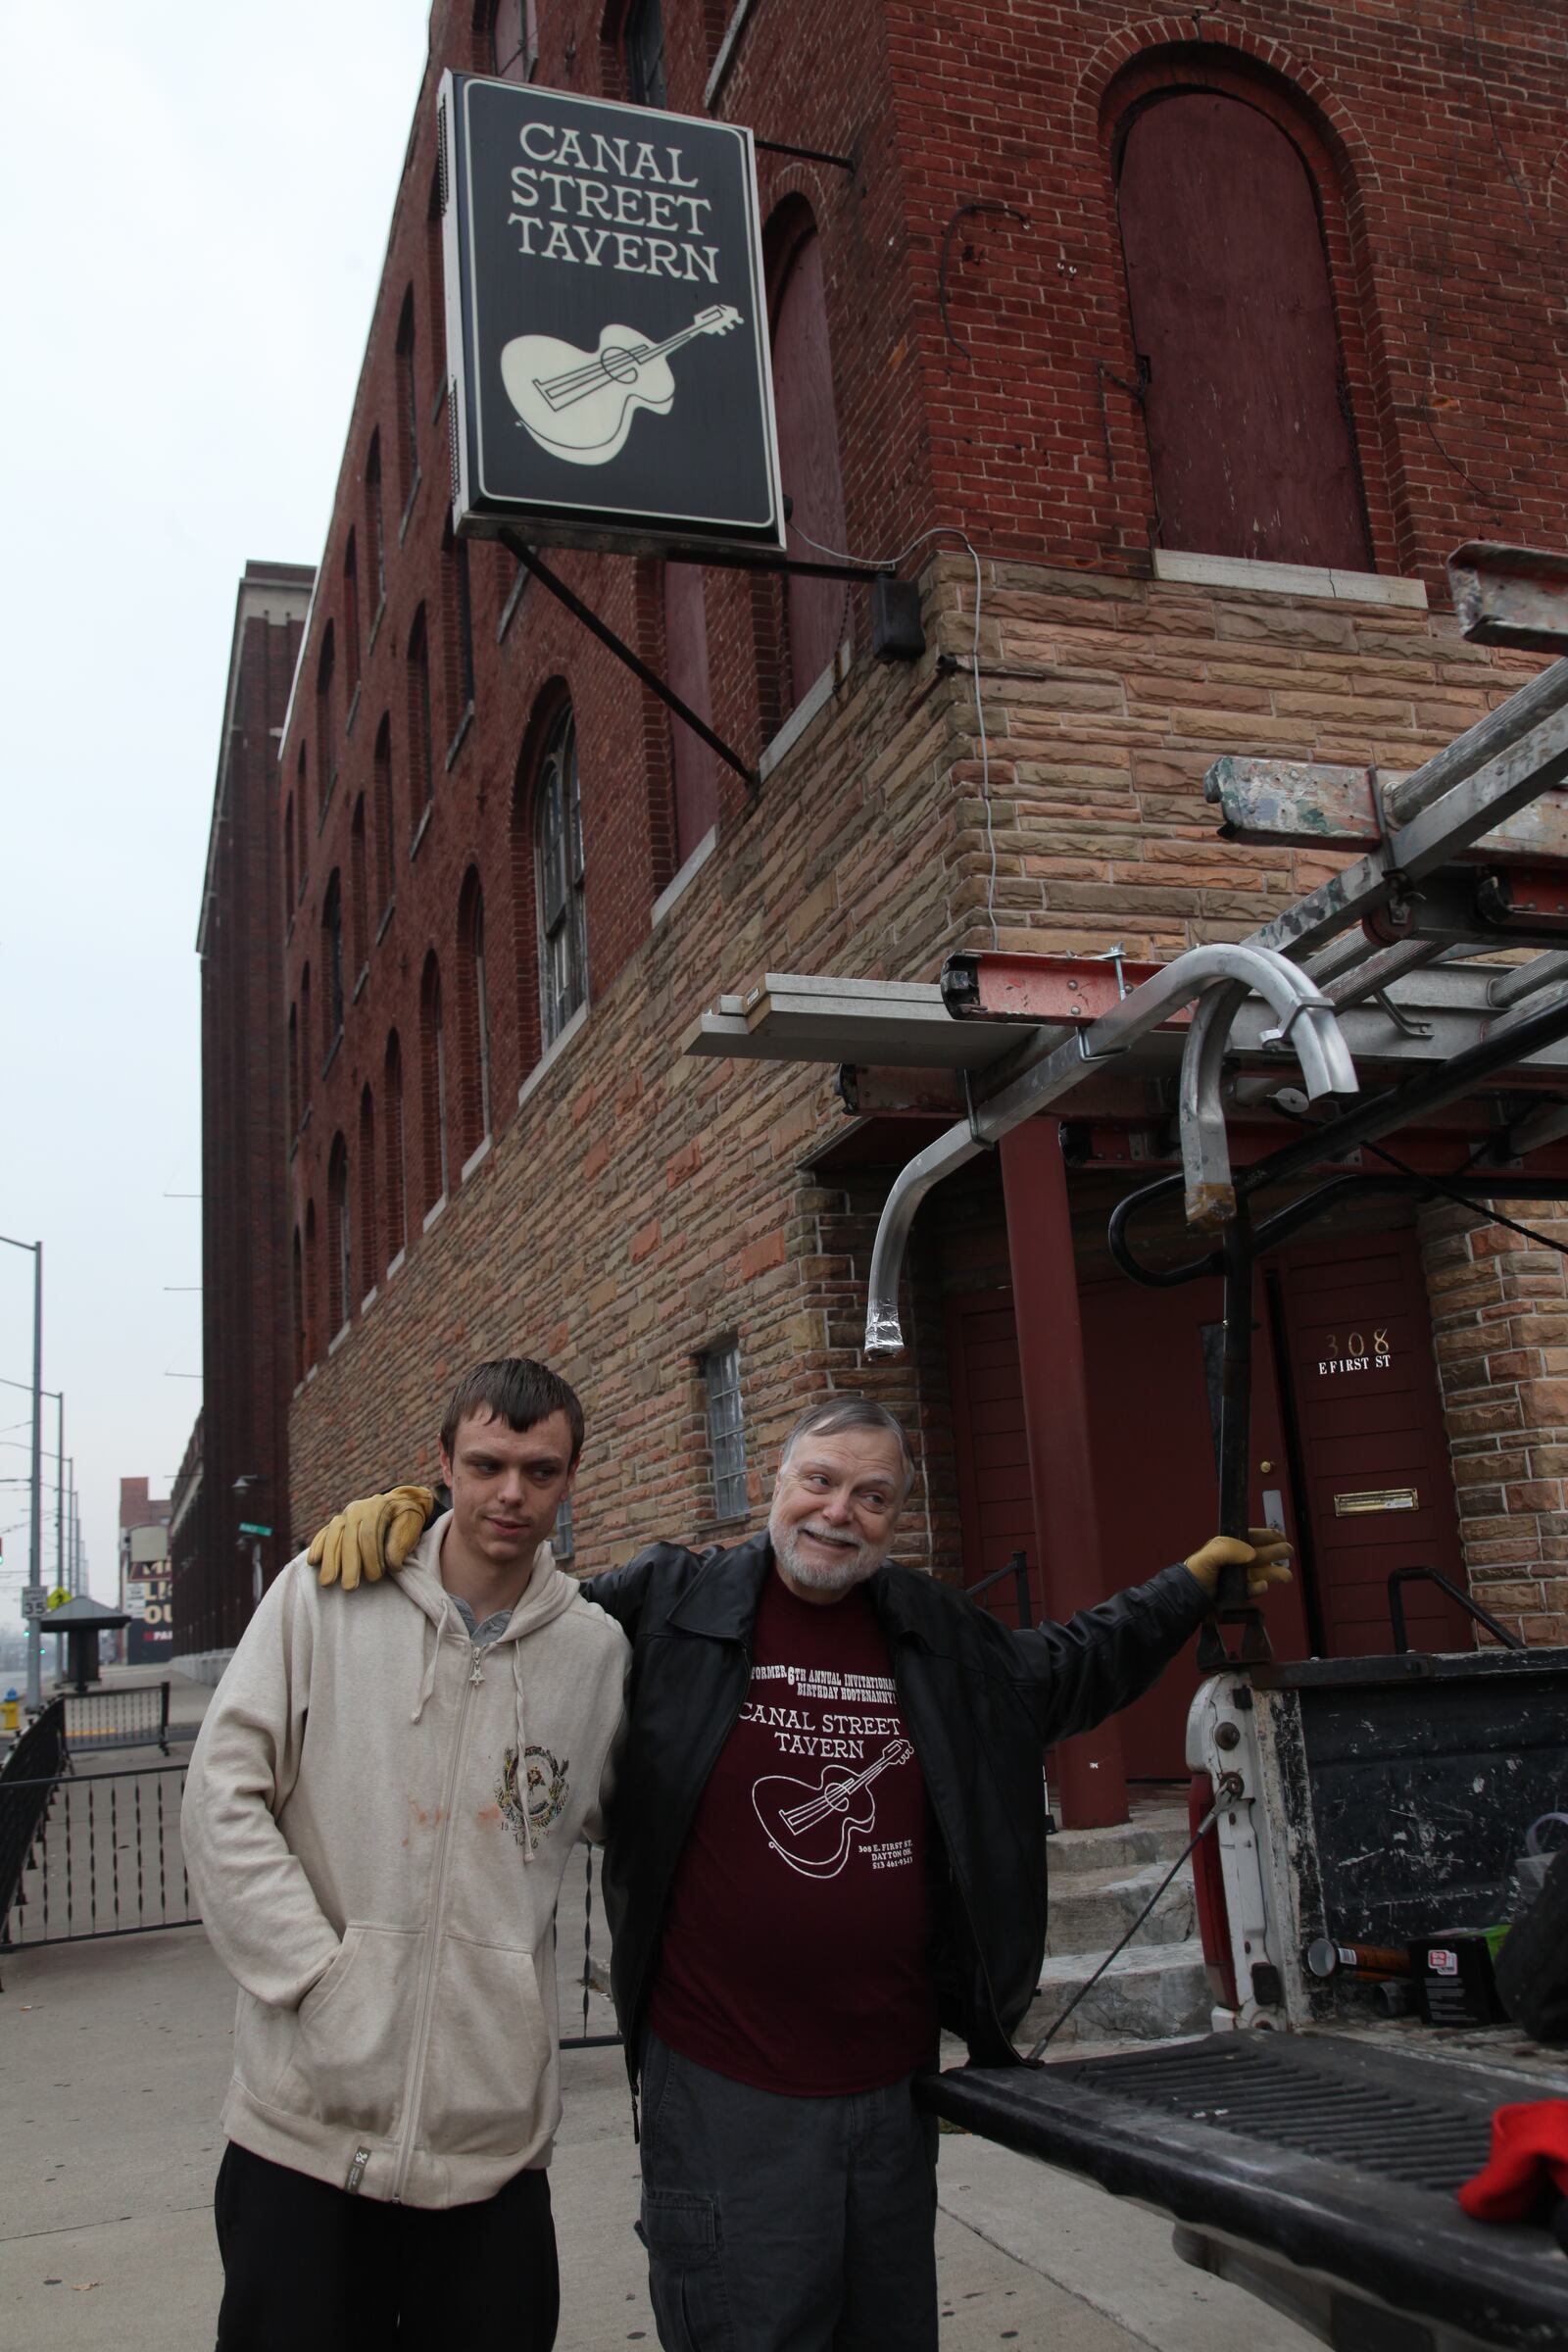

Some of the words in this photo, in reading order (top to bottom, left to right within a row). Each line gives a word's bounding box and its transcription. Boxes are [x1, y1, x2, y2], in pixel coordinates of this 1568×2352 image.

[519, 122, 699, 187] CANAL
[511, 167, 711, 235] STREET
[508, 213, 719, 284] TAVERN
[1326, 1327, 1390, 1359] 308
[1375, 1354, 1391, 1368] ST
[24, 1601, 46, 1615] 35
[788, 1666, 807, 1685] 6TH
[808, 1670, 842, 1686] ANNUAL
[797, 1683, 839, 1700] BIRTHDAY
[738, 1702, 815, 1731] CANAL
[822, 1714, 901, 1736] STREET
[774, 1732, 864, 1759] TAVERN
[871, 1849, 902, 1861] DAYTON
[881, 1841, 903, 1851] FIRST
